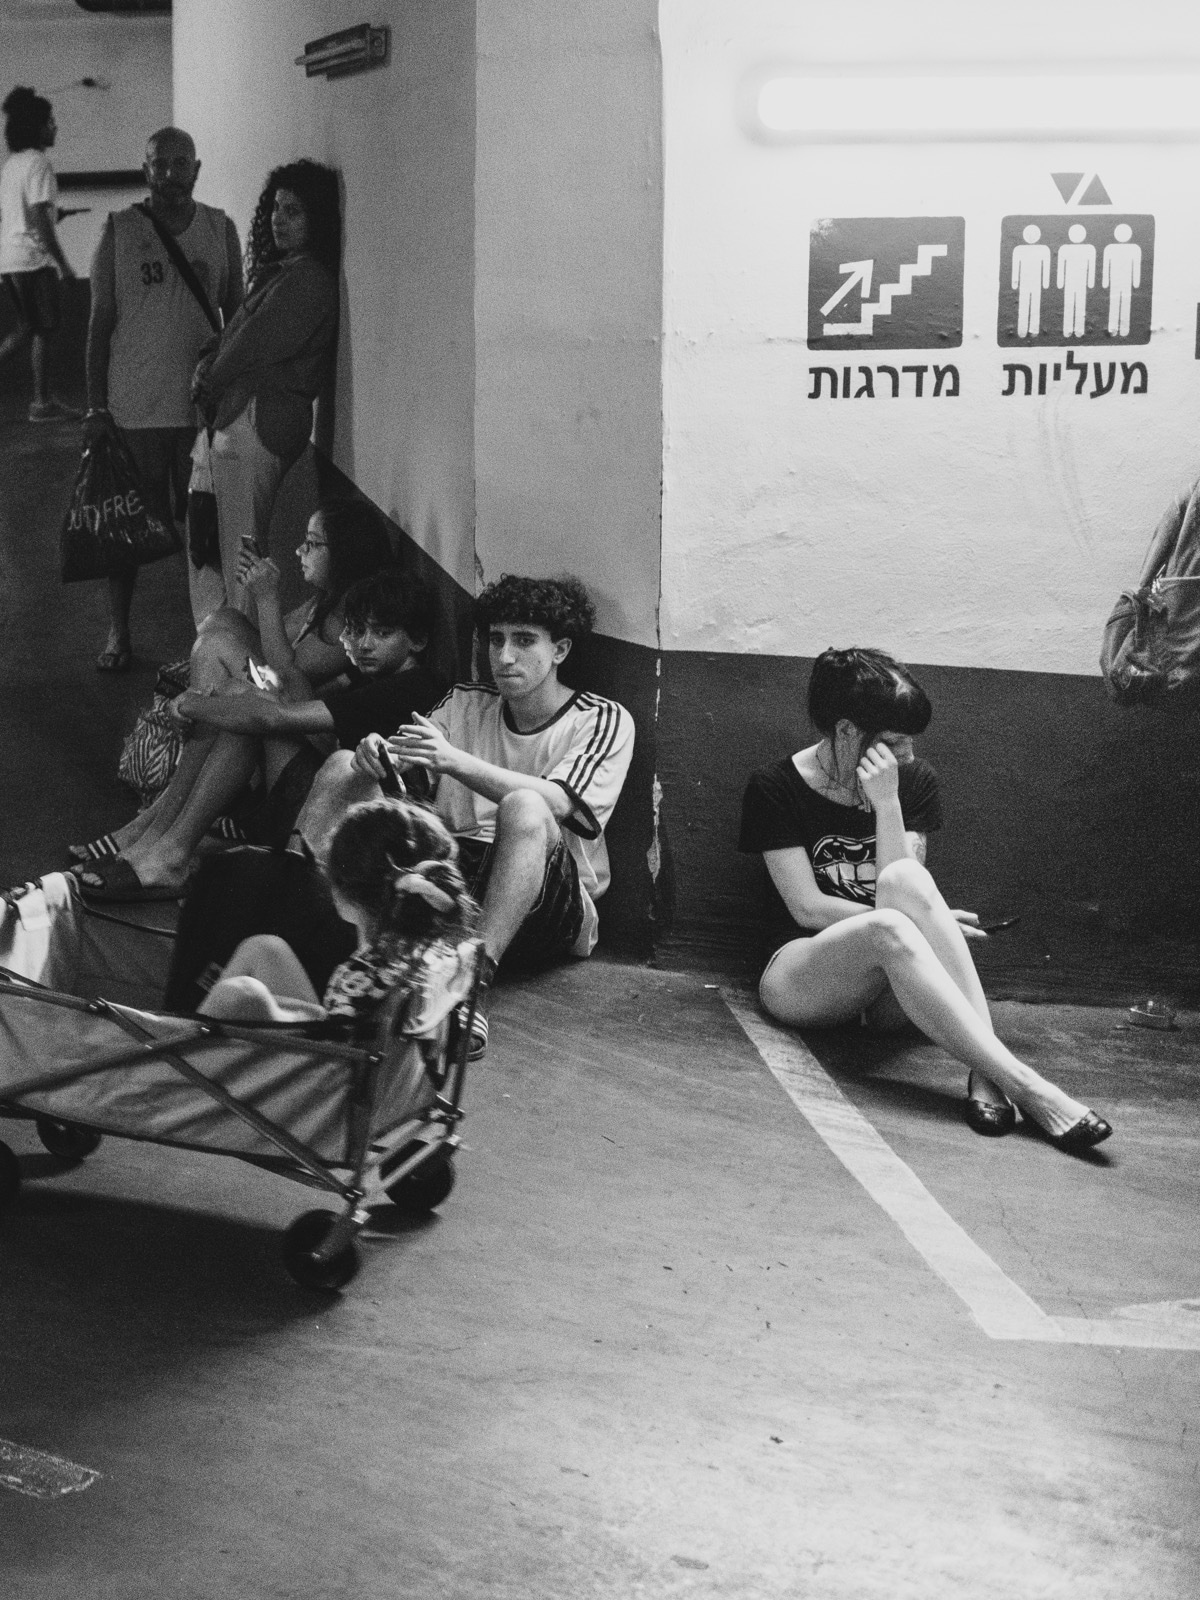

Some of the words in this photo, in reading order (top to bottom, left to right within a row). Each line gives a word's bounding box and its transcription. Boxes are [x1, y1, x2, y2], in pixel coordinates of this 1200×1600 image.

[140, 261, 164, 285] 33
[806, 363, 961, 400] מדרגות
[1001, 350, 1149, 400] מעליות
